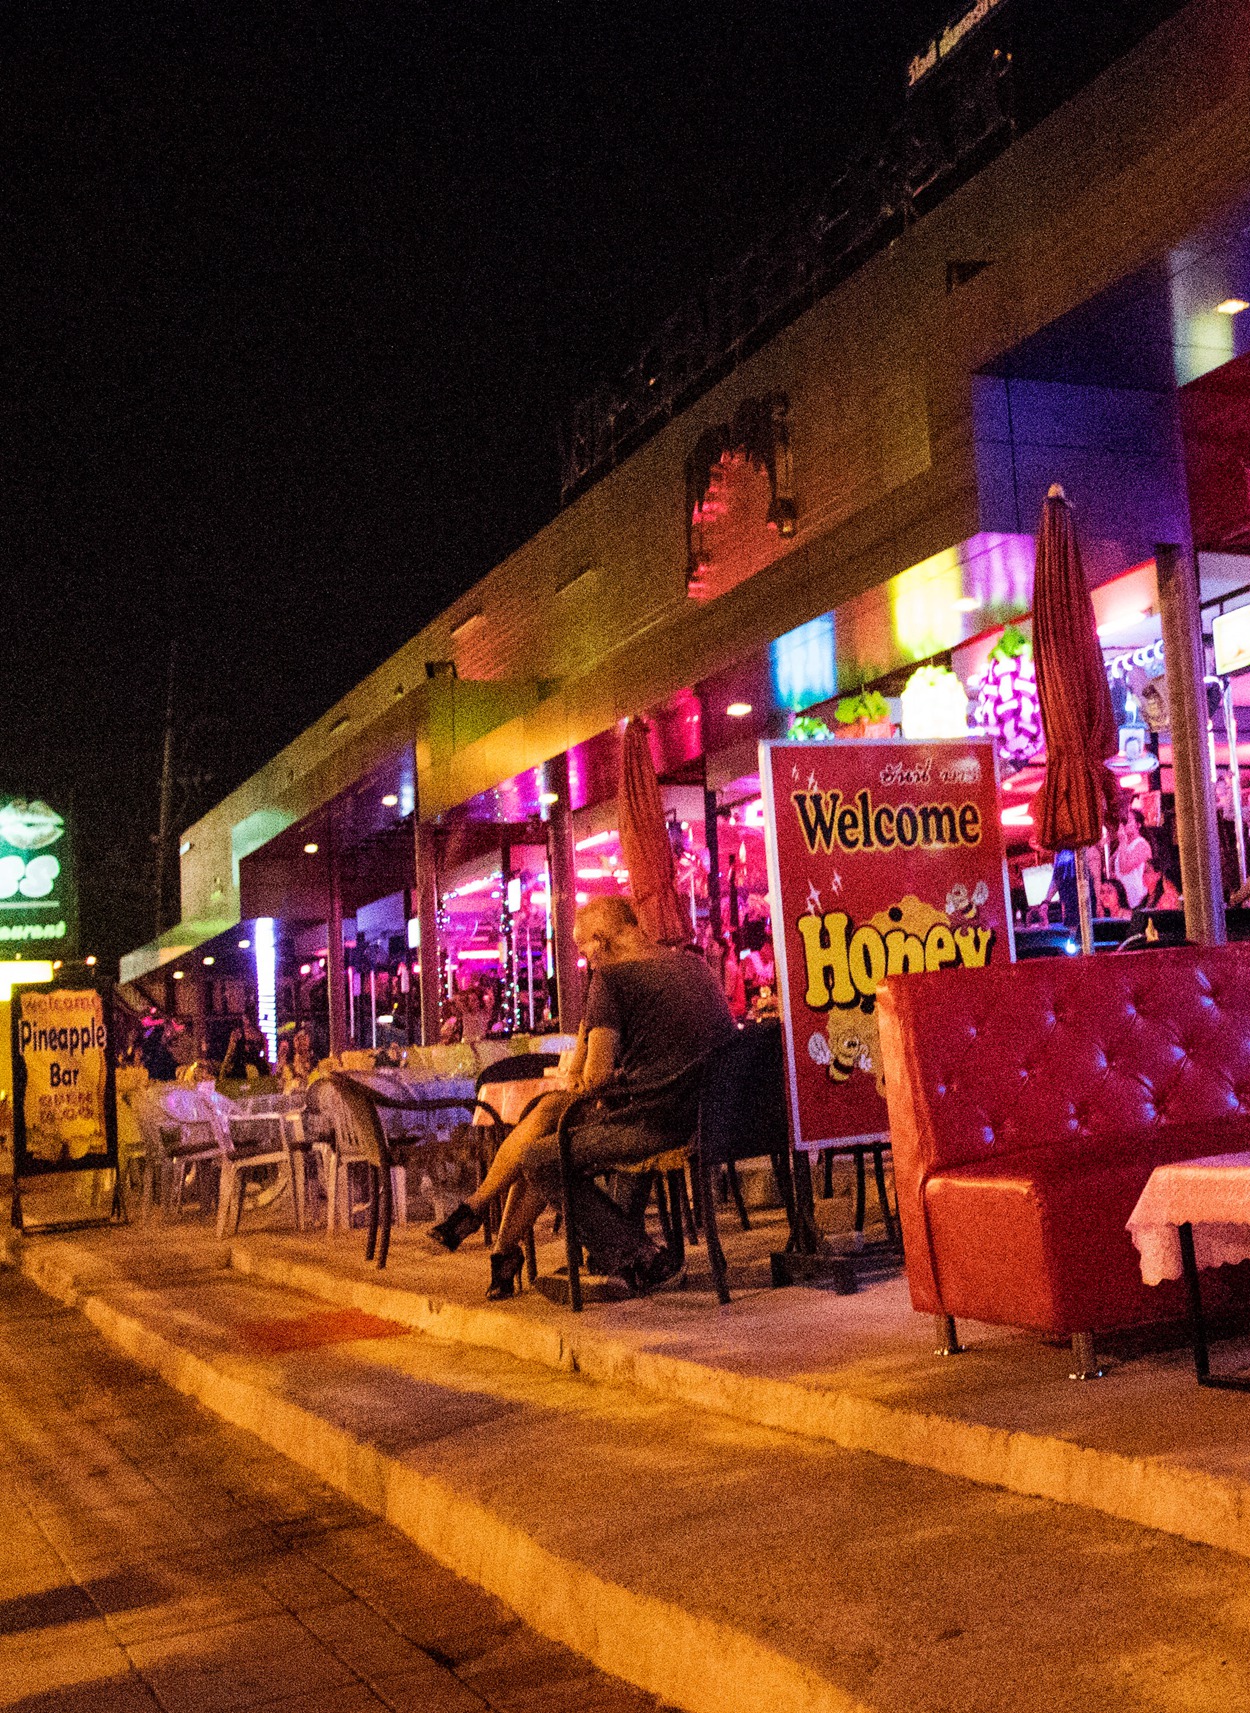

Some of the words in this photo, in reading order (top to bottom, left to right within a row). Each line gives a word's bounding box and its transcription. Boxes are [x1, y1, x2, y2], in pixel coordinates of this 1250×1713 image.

[793, 789, 983, 853] Welcome
[20, 1016, 107, 1057] Pineapple
[50, 1062, 80, 1088] Bar
